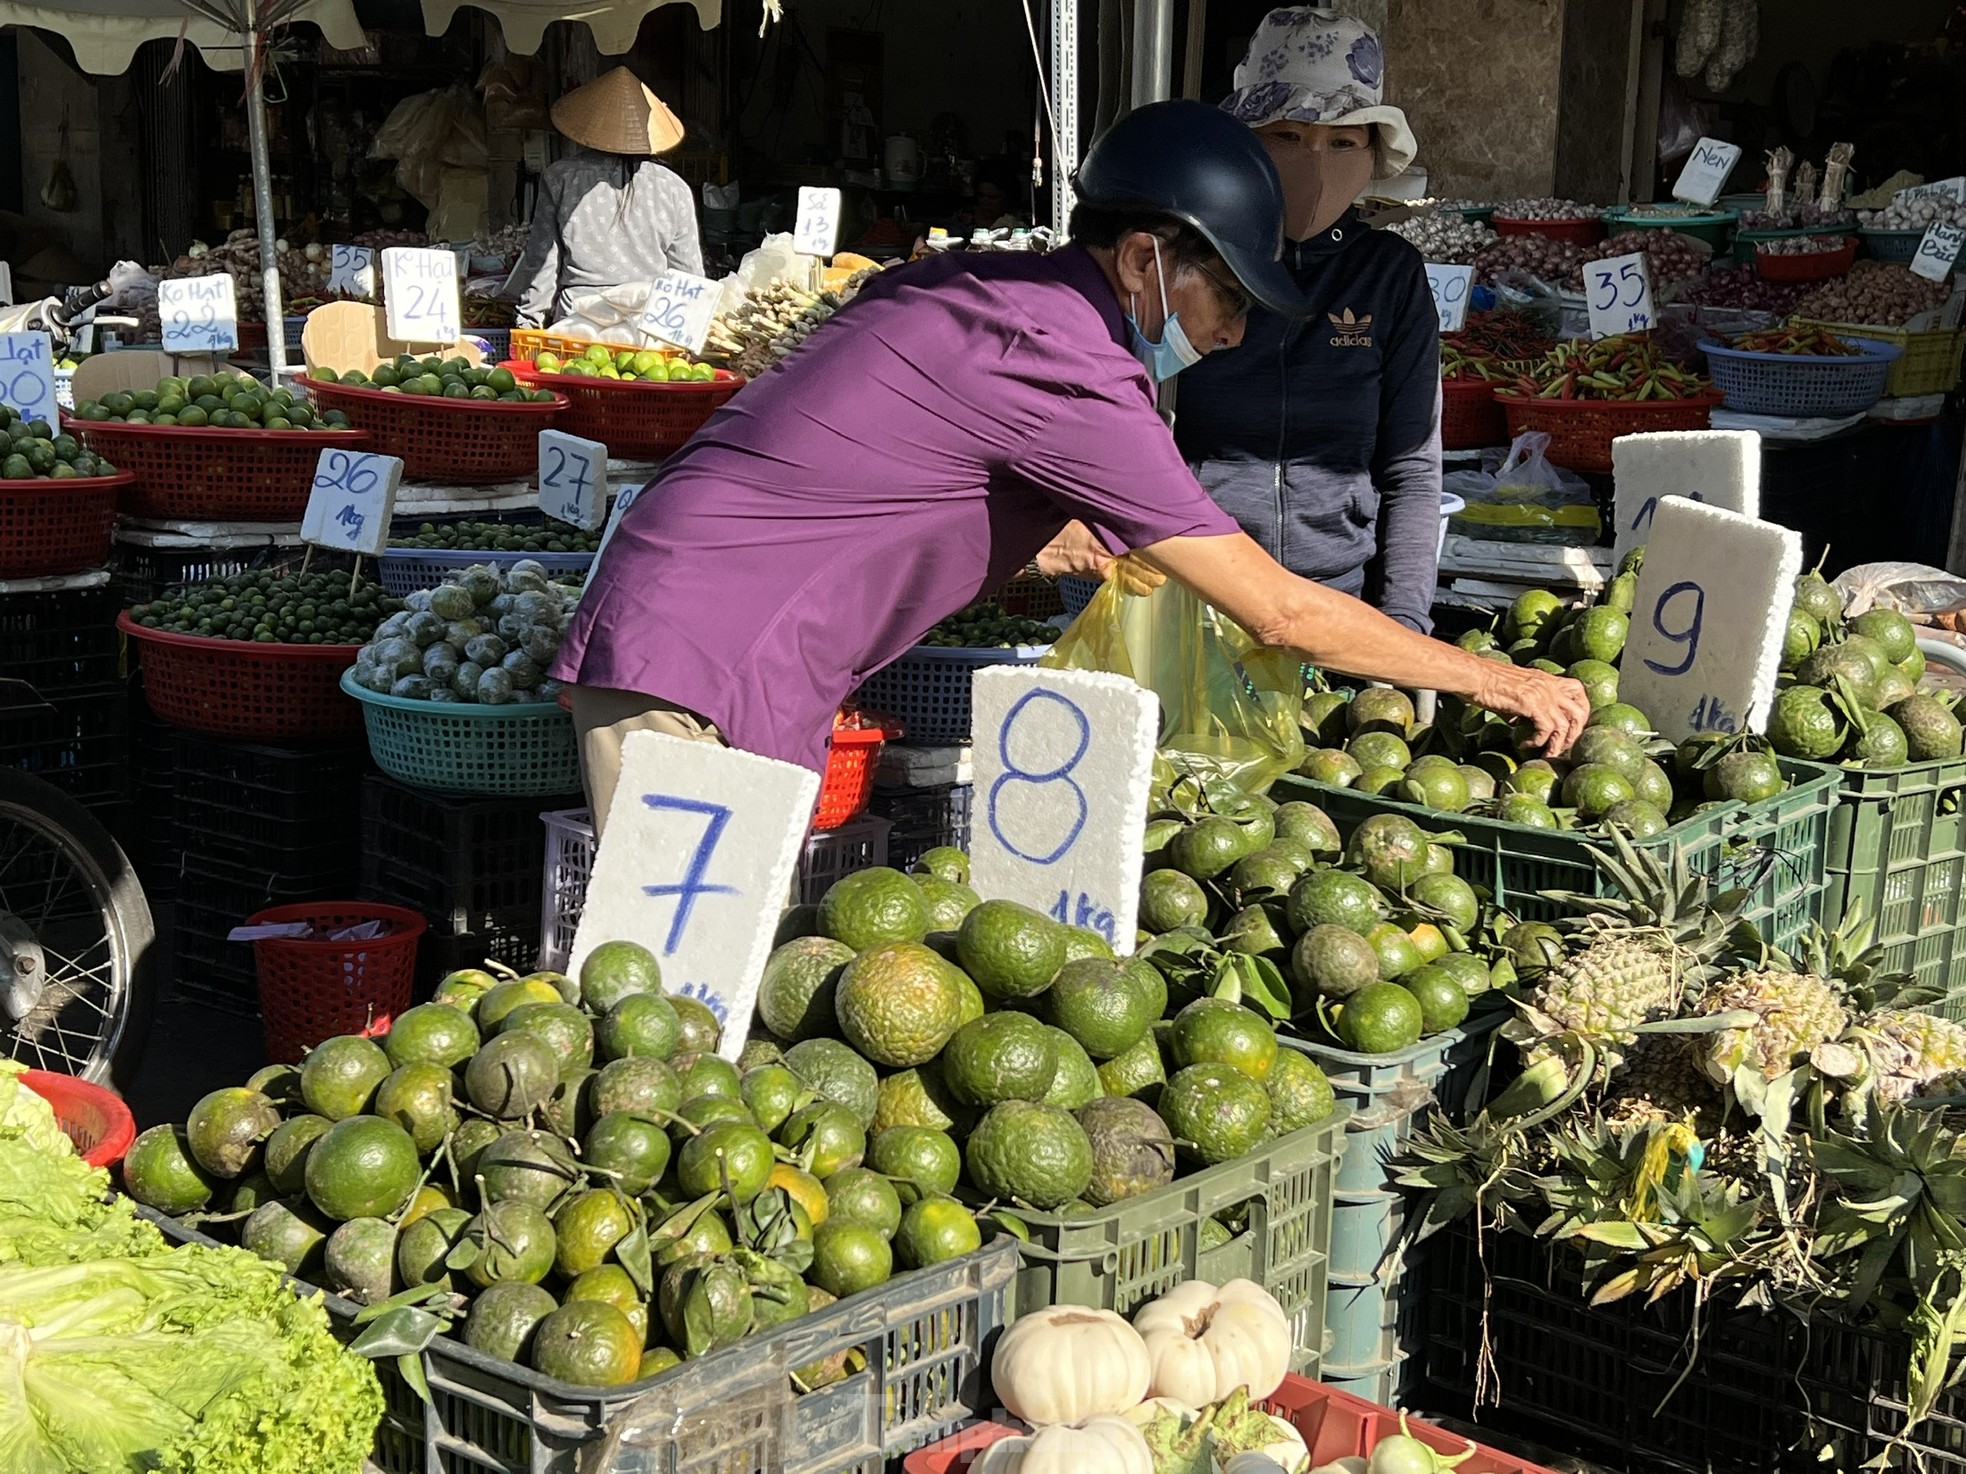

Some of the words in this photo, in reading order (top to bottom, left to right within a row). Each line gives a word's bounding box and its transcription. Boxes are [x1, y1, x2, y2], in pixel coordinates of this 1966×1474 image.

[802, 216, 829, 236] 13
[333, 245, 370, 272] 35
[402, 284, 448, 323] 24
[1595, 262, 1646, 311] 35
[166, 304, 218, 340] 22
[643, 297, 688, 330] 26
[1329, 334, 1373, 348] adidas
[313, 452, 380, 494] 26
[542, 446, 594, 505] 27
[1643, 580, 1705, 677] 9
[987, 686, 1091, 865] 8
[641, 793, 742, 956] 7
